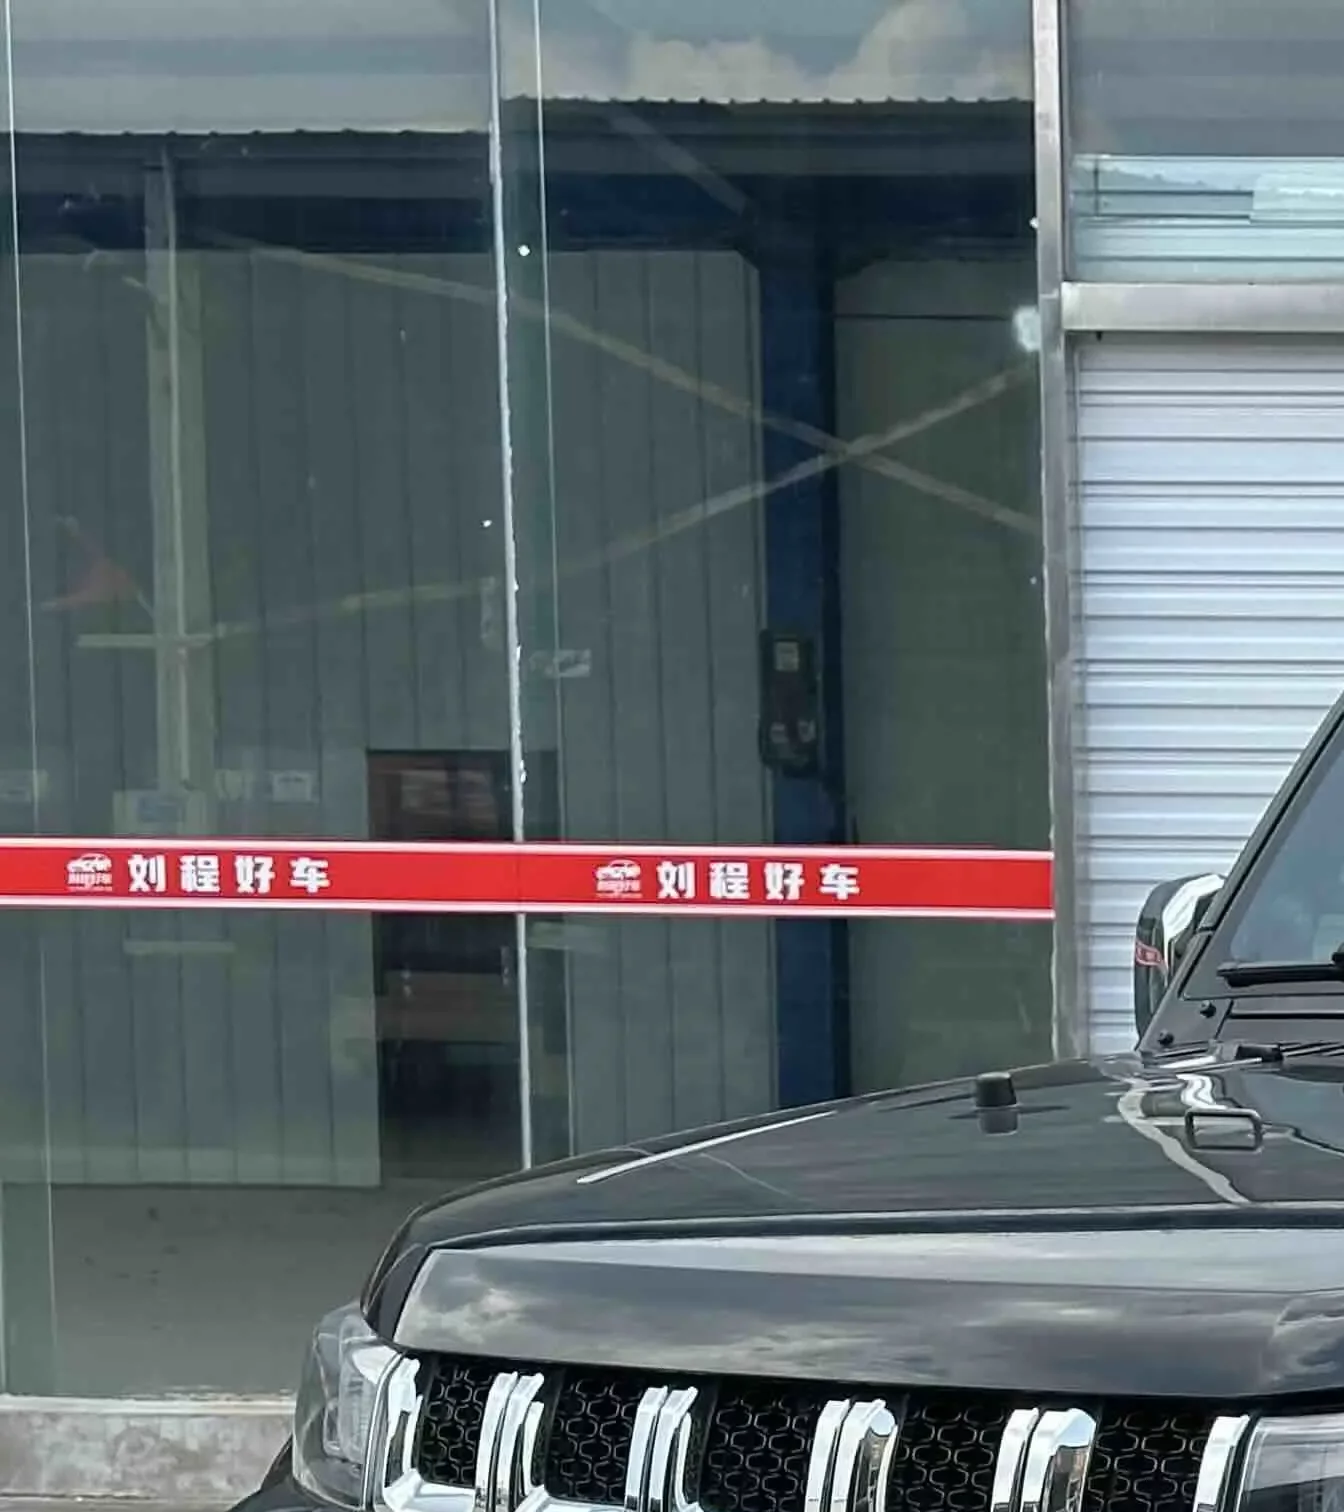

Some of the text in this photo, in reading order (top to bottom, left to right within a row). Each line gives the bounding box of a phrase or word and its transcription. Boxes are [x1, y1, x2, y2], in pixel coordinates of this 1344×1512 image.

[127, 853, 331, 894] 刘程好车
[655, 860, 861, 901] 刘程好车
